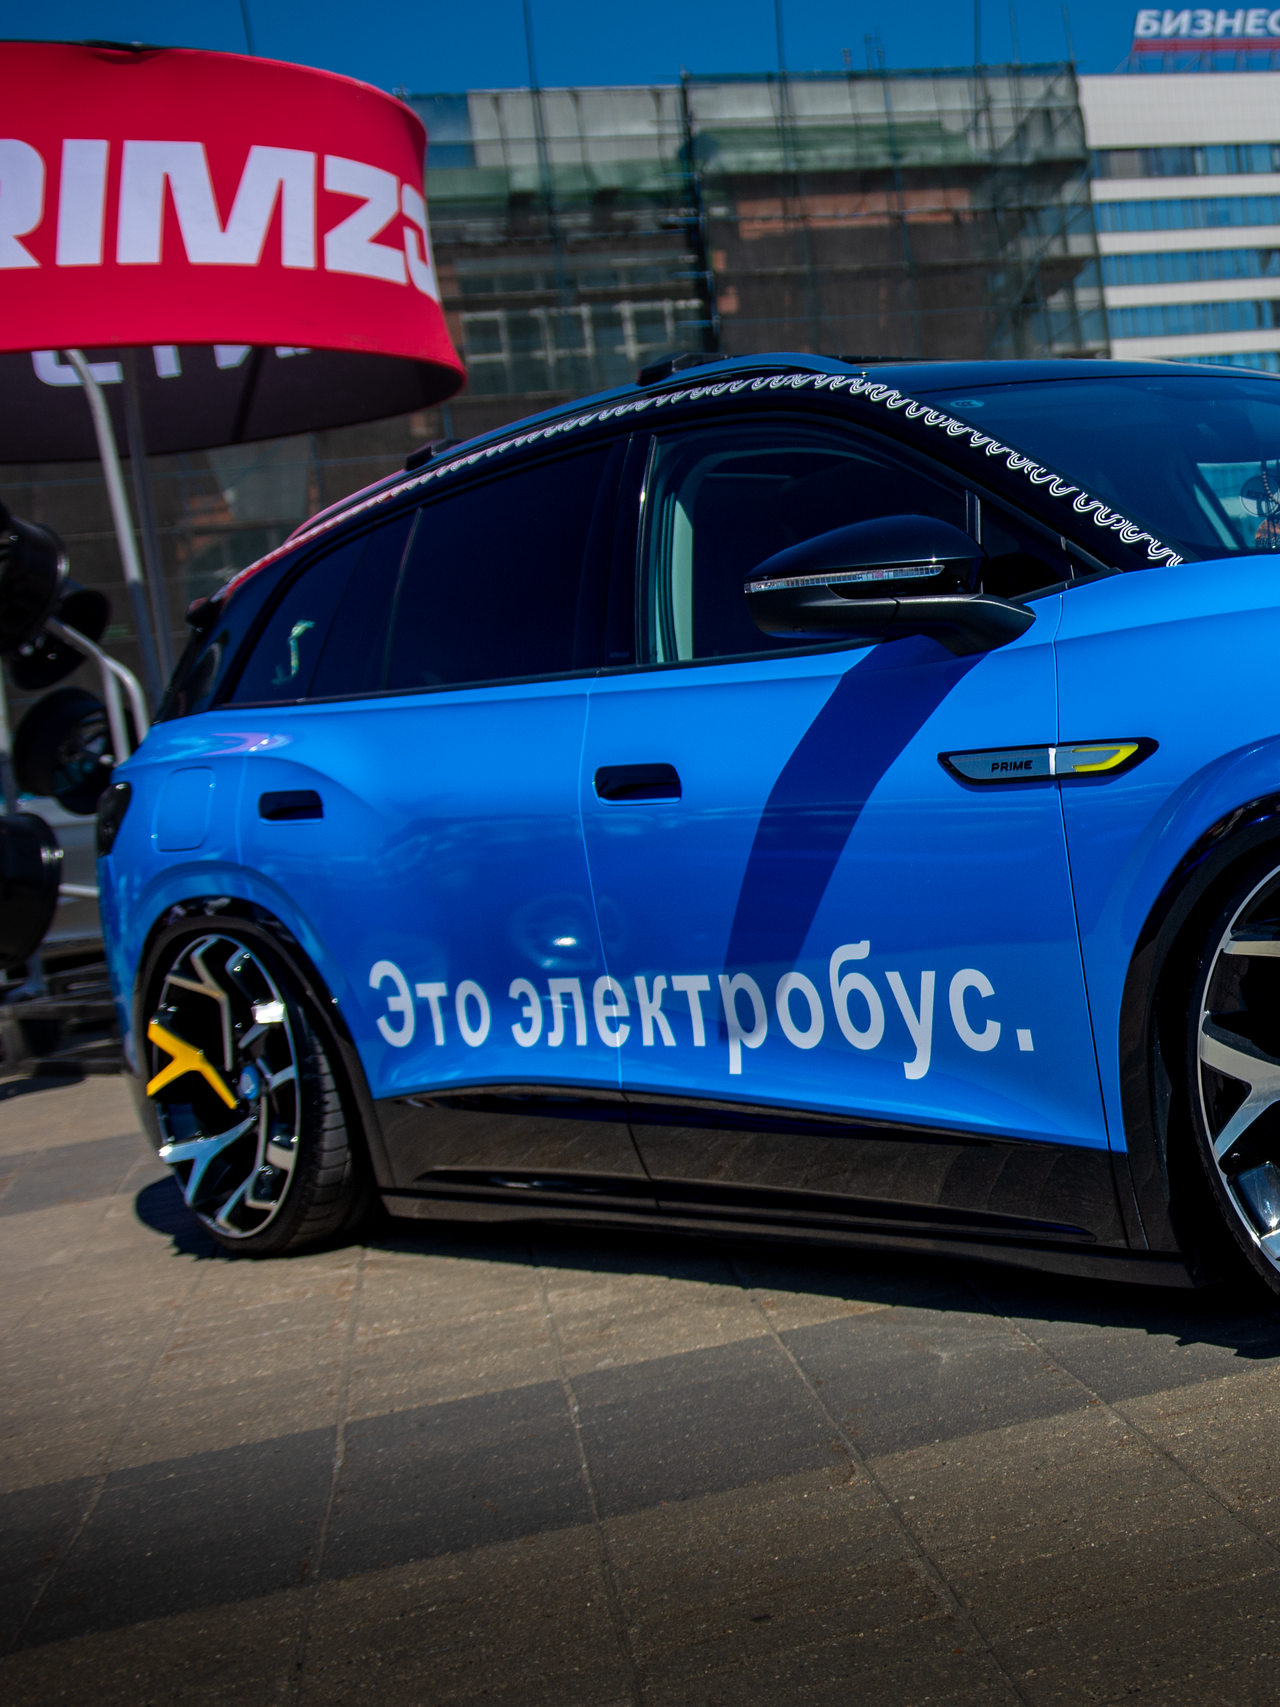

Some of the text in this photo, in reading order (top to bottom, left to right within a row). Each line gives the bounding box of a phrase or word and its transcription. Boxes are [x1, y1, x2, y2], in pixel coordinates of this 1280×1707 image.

[991, 760, 1033, 772] PRIME
[368, 940, 1035, 1080] Это электробус.
